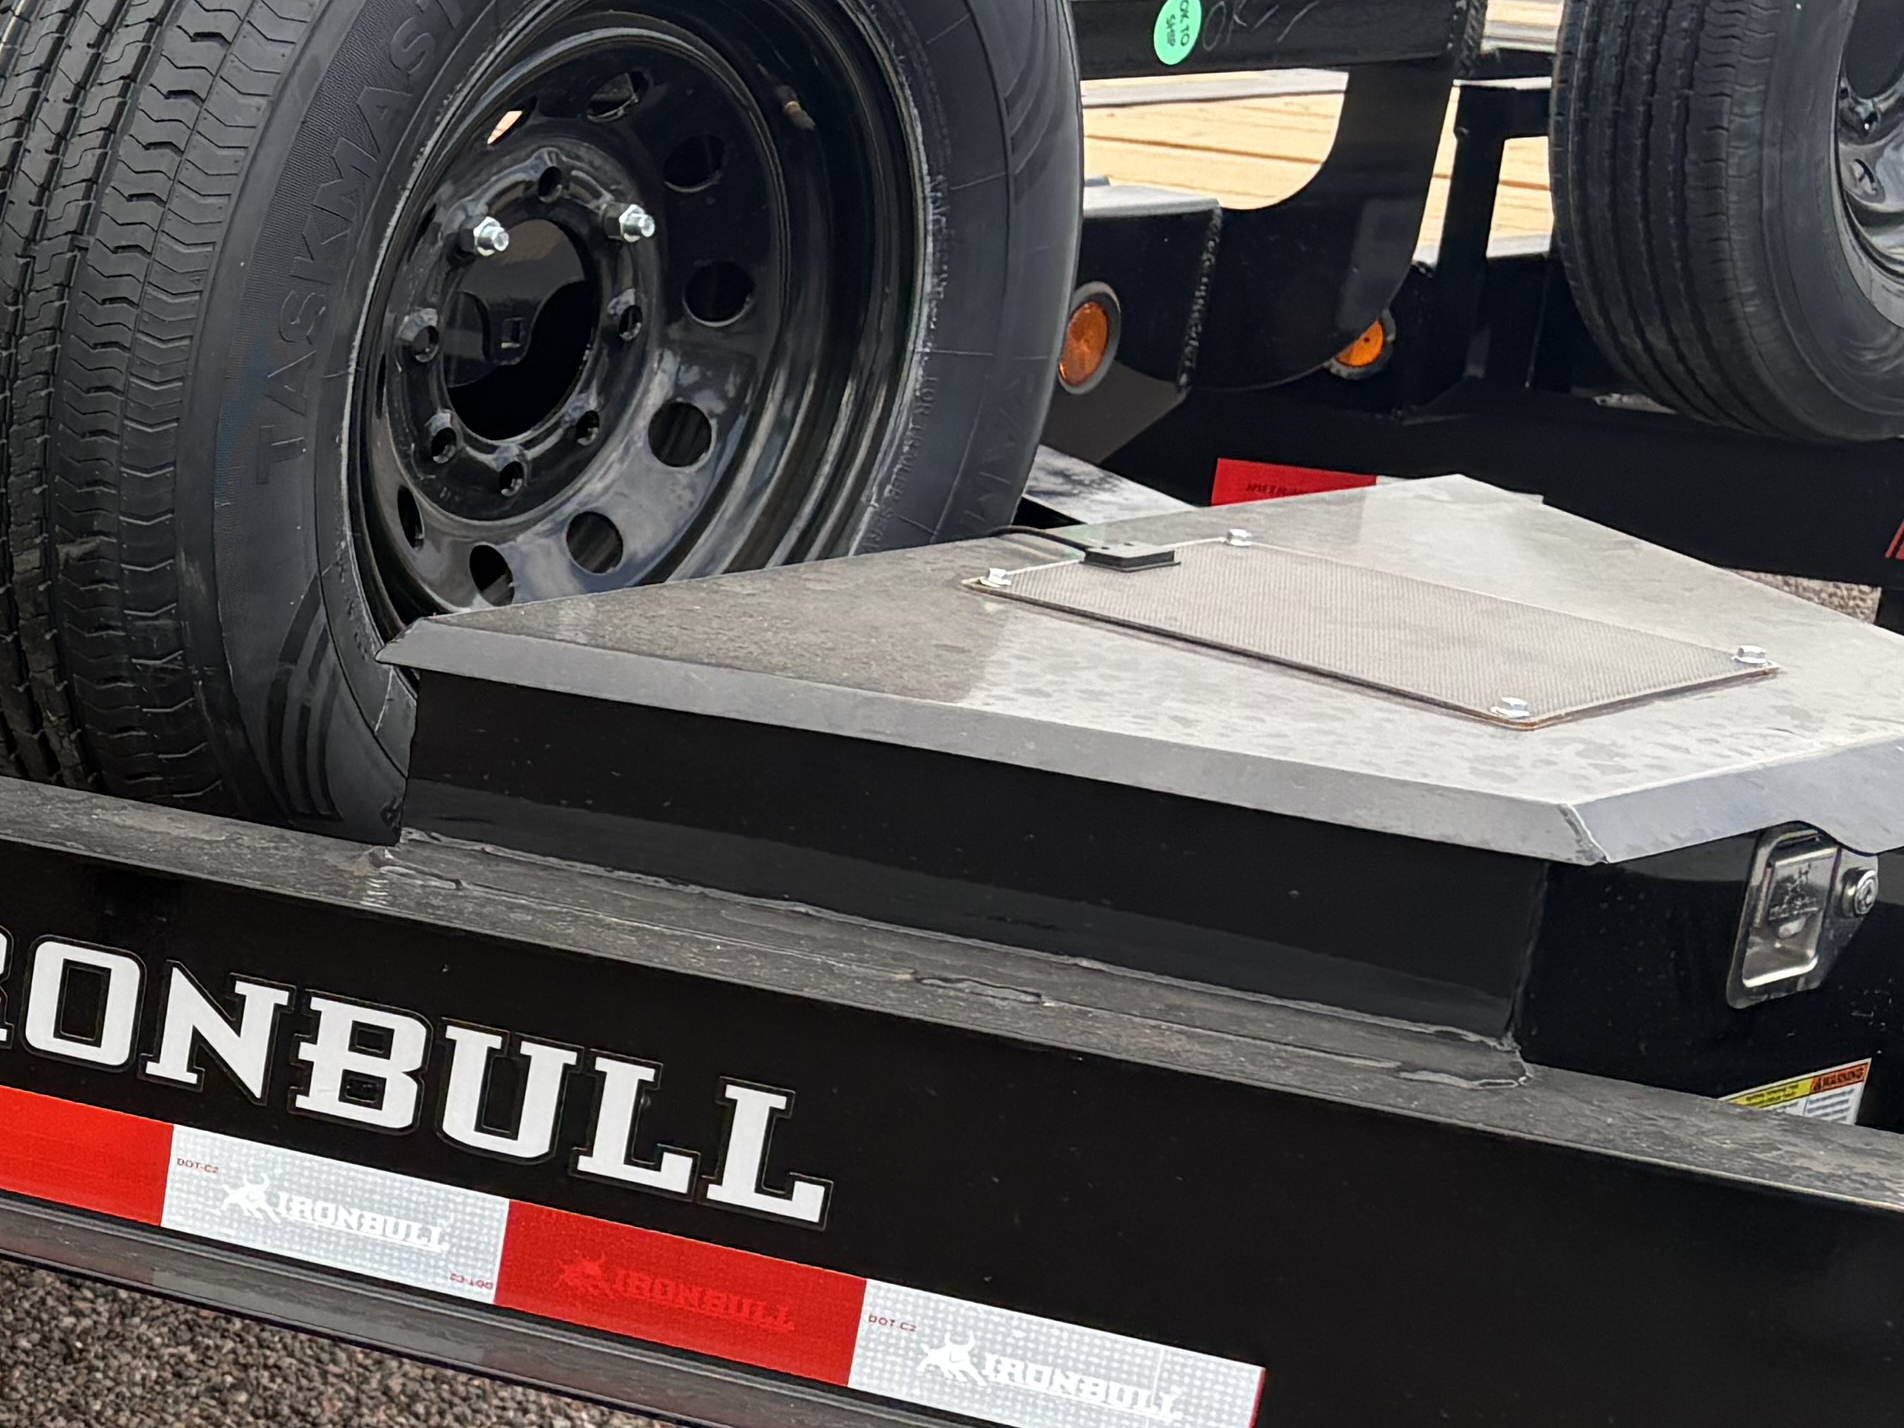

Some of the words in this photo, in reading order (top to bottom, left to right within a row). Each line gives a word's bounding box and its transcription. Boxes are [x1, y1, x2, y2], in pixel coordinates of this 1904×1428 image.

[176, 1157, 220, 1174] DOT-C2
[277, 1191, 451, 1253] IRONBULL
[612, 1267, 796, 1332] IRONBULL
[867, 1312, 918, 1333] DOT-C2
[982, 1353, 1184, 1423] IRONBULL
